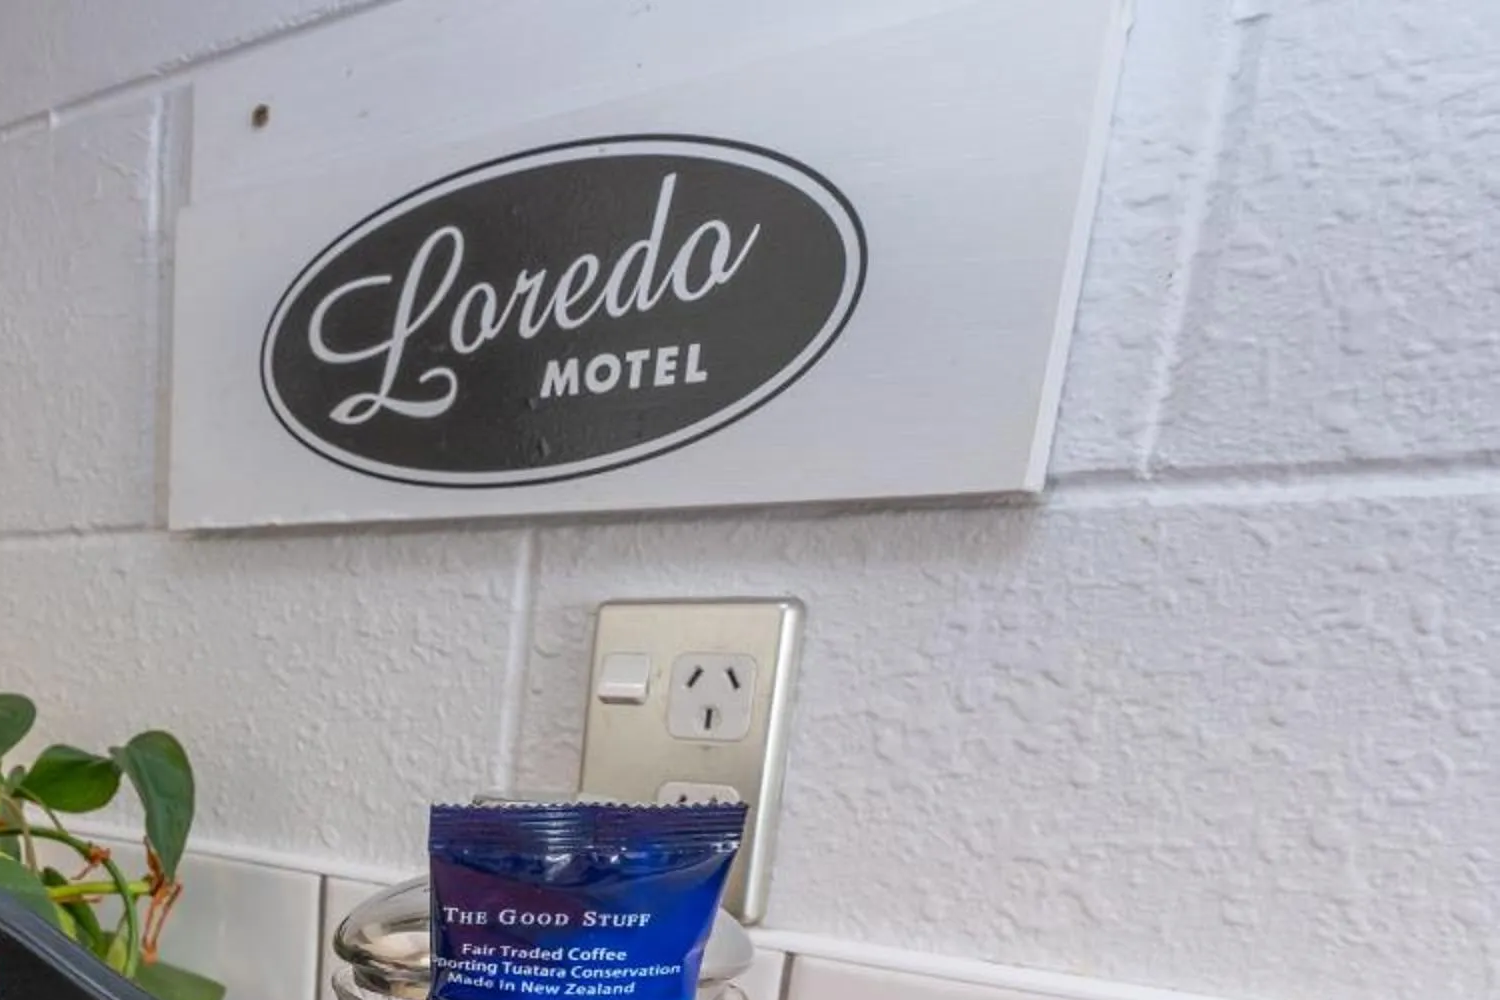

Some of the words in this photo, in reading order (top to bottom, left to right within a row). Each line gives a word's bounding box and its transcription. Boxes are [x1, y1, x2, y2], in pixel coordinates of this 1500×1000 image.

[308, 173, 760, 425] Loredo
[540, 344, 708, 399] MOTEL
[443, 907, 488, 925] THE
[499, 909, 570, 927] GOOD
[583, 911, 651, 928] STUFF
[461, 943, 496, 956] Fair
[500, 945, 563, 961] Traded
[567, 947, 627, 962] Coffee
[502, 961, 567, 979] Tuatara
[570, 963, 681, 979] Conservation
[447, 972, 494, 989] Made
[499, 979, 516, 992] in
[521, 981, 560, 996] New
[564, 981, 636, 996] Zealand
